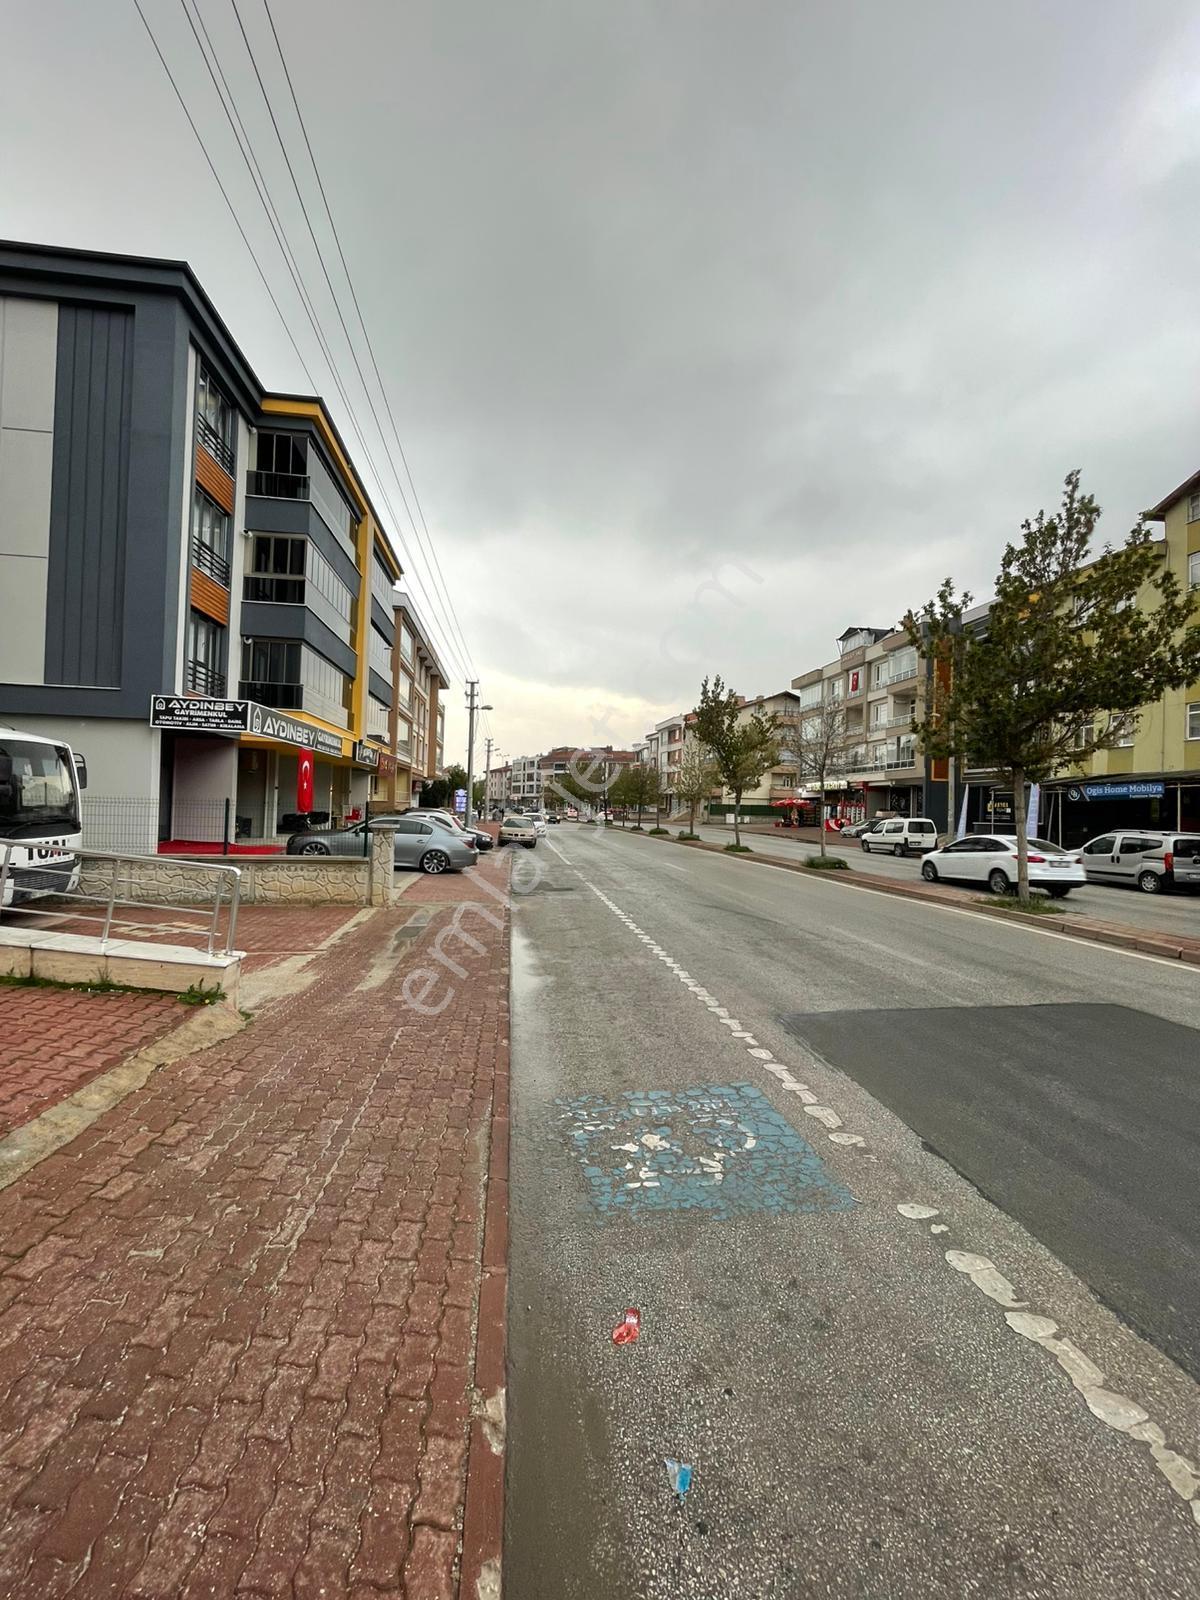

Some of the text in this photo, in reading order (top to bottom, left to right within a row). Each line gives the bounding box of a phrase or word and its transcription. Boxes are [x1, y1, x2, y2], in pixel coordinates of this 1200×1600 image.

[168, 700, 246, 711] AYDINBEY
[263, 716, 315, 745] AYDINBEY
[1104, 785, 1128, 794] Home
[1129, 784, 1162, 793] Mobilya
